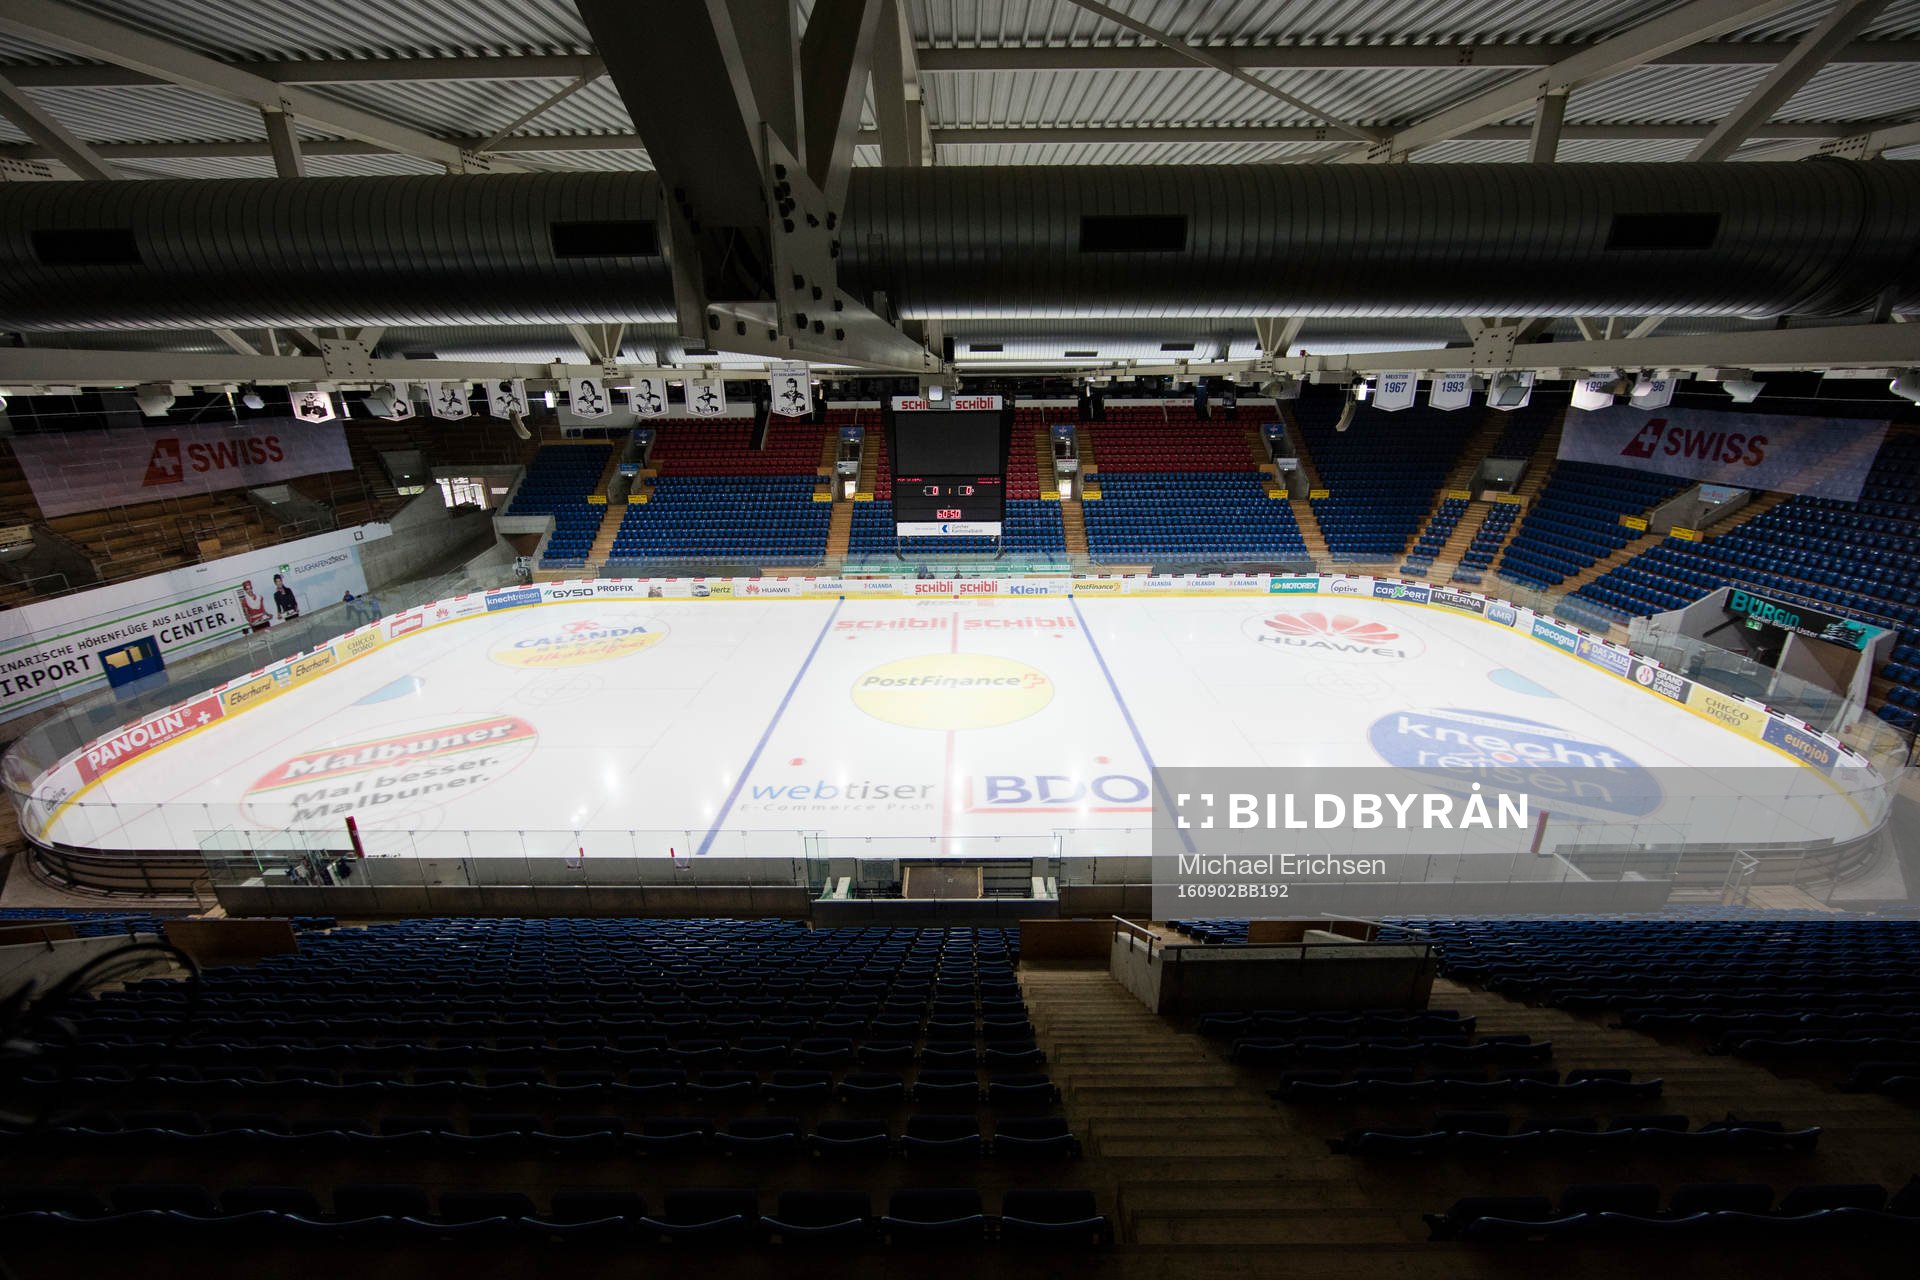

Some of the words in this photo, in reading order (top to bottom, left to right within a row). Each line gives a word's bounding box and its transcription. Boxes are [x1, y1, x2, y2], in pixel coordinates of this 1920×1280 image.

[1384, 382, 1407, 393] 1967
[1441, 381, 1464, 393] 1993
[191, 435, 284, 473] SWISS
[1663, 427, 1768, 467] SWISS
[552, 588, 593, 599] GYSO
[710, 586, 731, 594] Hertz
[1010, 585, 1048, 595] Klein
[1282, 582, 1318, 590] MOTOREX
[1333, 584, 1358, 594] optive
[1435, 592, 1480, 607] INTERNA
[78, 622, 148, 651] HÖHENFLÜGE
[152, 616, 171, 628] AUS
[174, 606, 204, 622] ALLER
[207, 597, 233, 612] WELT:
[1489, 609, 1512, 621] AMR
[160, 612, 236, 644] CENTER.
[514, 626, 648, 648] CALANDA
[1534, 624, 1575, 649] specogna
[1258, 635, 1406, 658] HUAWEI
[1592, 645, 1608, 658] DAS
[1608, 652, 1628, 667] PLUS
[295, 654, 330, 677] Eberhard
[862, 674, 1022, 688] PostFinance
[1655, 677, 1681, 693] CASINO
[1656, 671, 1683, 686] GRAND
[230, 679, 272, 706] Eberhard
[1653, 684, 1679, 699] BADEN
[1705, 697, 1749, 721] CHICCO
[280, 722, 517, 780] Malbuner
[1397, 716, 1627, 775] knecht
[1784, 732, 1829, 764] eurojob
[291, 781, 362, 806] Mal
[375, 755, 500, 789] besser.
[1418, 750, 1613, 802] reisen
[291, 773, 490, 823] Malbuner.
[752, 780, 935, 800] webtiser
[985, 774, 1150, 804] BDO
